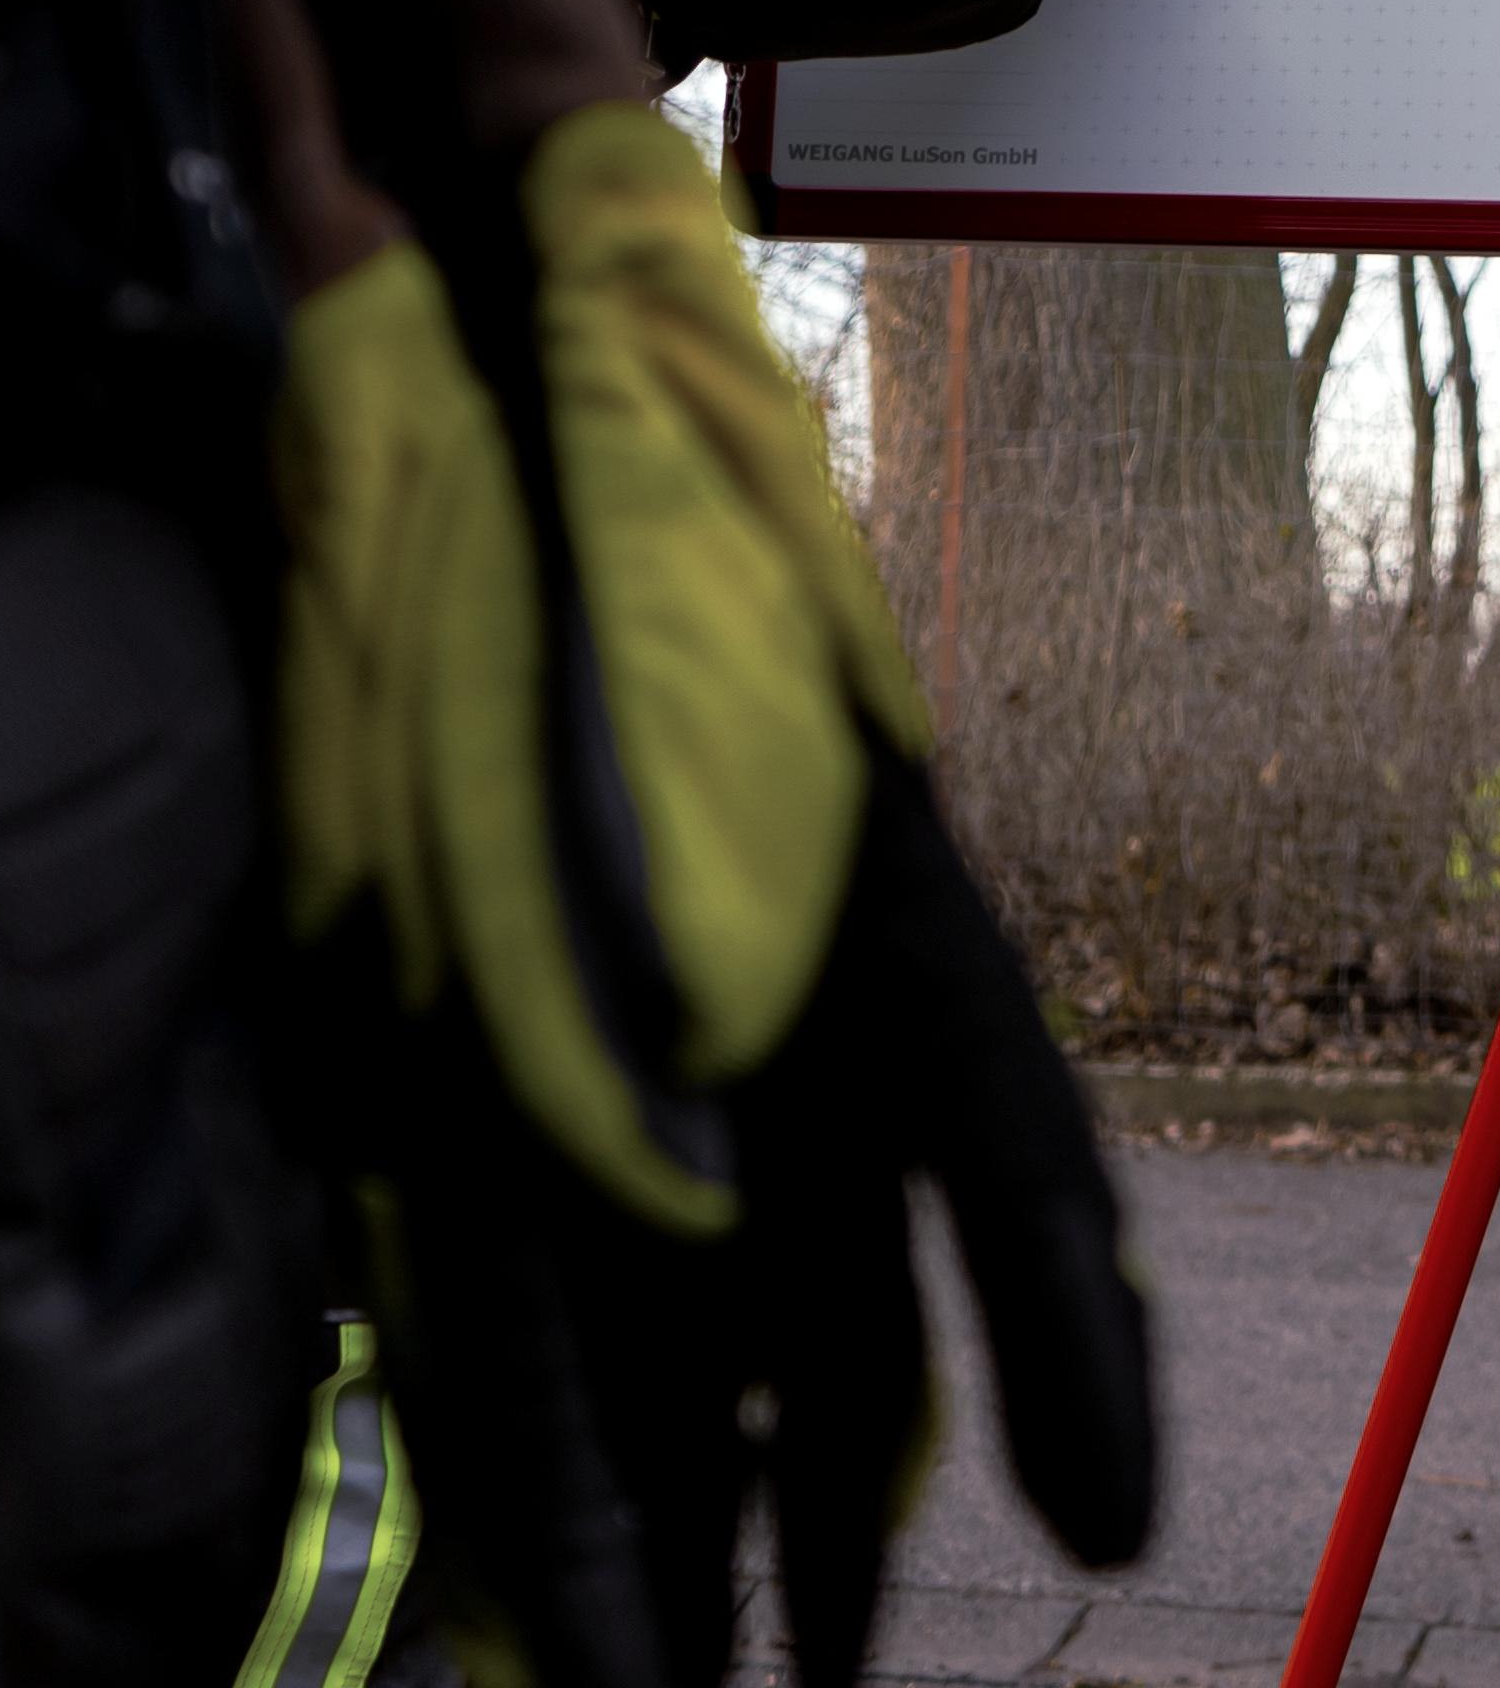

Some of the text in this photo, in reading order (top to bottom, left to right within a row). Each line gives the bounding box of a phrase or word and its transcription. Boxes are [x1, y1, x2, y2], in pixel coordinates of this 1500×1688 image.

[787, 143, 1038, 166] WEIGANG LuSon GmbH
